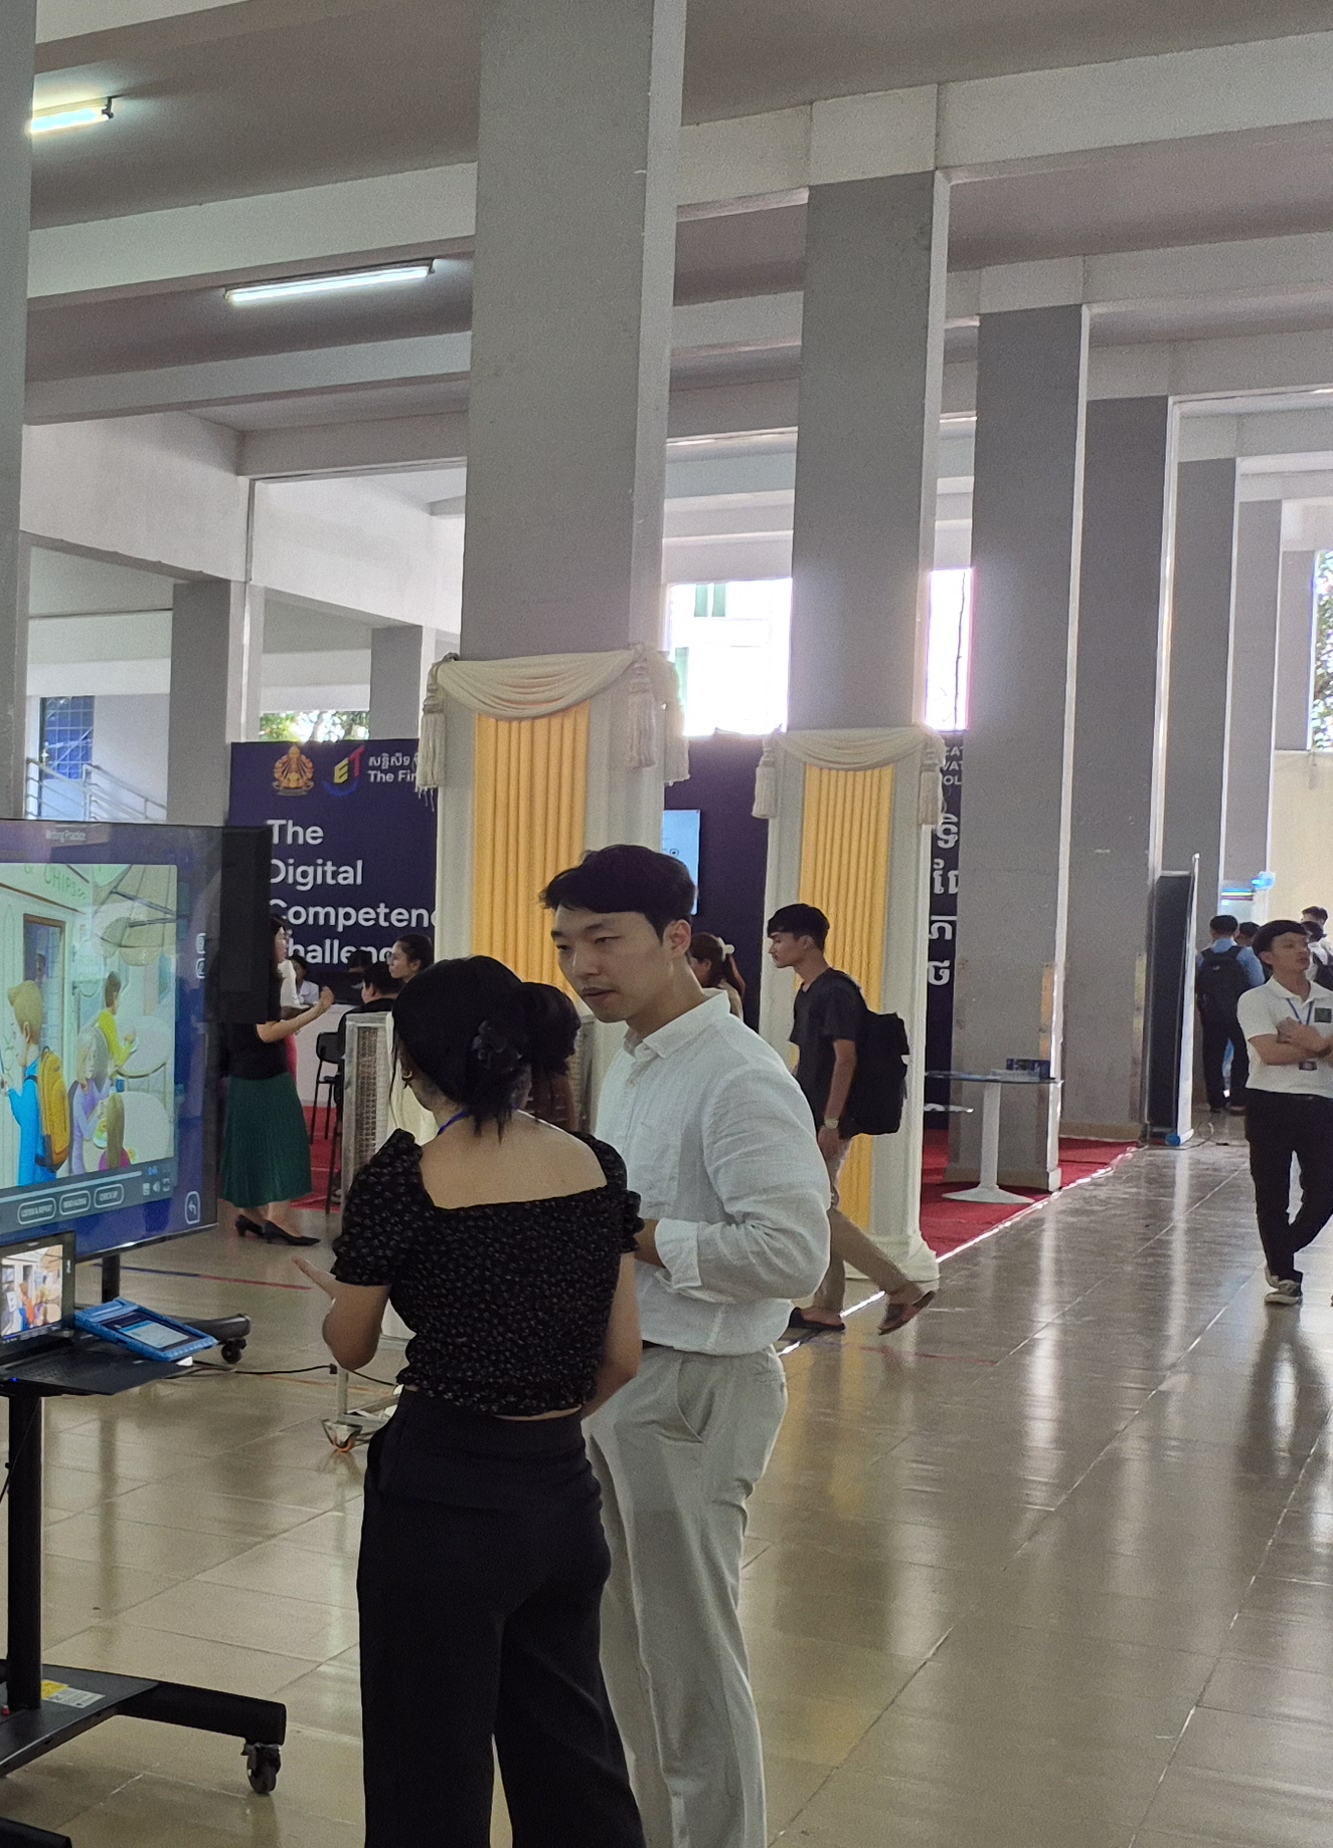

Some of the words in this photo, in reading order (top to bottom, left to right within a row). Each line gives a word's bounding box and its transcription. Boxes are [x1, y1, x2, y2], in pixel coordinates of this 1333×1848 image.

[367, 770, 394, 782] The
[266, 819, 324, 845] The
[270, 859, 363, 891] Digital
